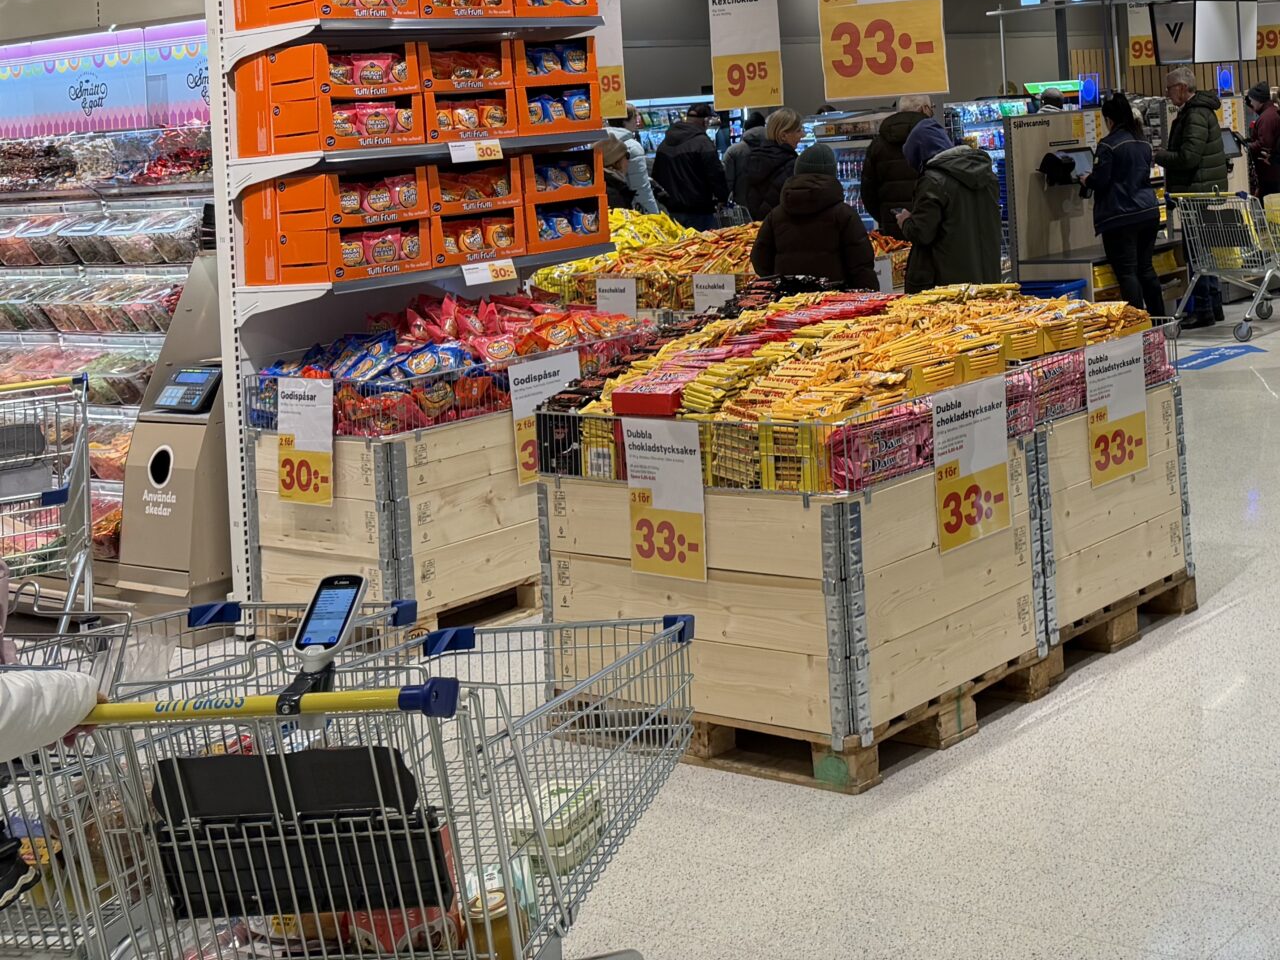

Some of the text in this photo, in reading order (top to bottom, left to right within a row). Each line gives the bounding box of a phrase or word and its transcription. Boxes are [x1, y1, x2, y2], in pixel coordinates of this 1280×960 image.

[831, 19, 934, 78] 33:-
[1013, 119, 1050, 130] Självscanning
[478, 147, 500, 158] 30:-
[491, 267, 514, 278] 30:-
[1088, 354, 1109, 366] Dubbla
[1088, 355, 1142, 377] chokladstycksaker
[513, 368, 560, 387] Godispåsar
[280, 390, 317, 403] Godispåsar
[935, 400, 962, 415] Dubbla
[936, 401, 1003, 428] chokladstycksaker
[1090, 411, 1106, 424] 3 för
[517, 422, 523, 431] 2
[279, 436, 294, 447] 2 för
[626, 429, 652, 440] Dubbla
[628, 442, 697, 456] chokladstycksaker
[1094, 428, 1143, 472] 33:-
[281, 458, 329, 494] 30:-
[937, 465, 957, 481] 3 för
[142, 490, 177, 504] Använda
[631, 492, 650, 503] 3 för
[145, 504, 172, 517] skedar
[943, 484, 1004, 534] 33:-
[635, 518, 699, 564] 33:-
